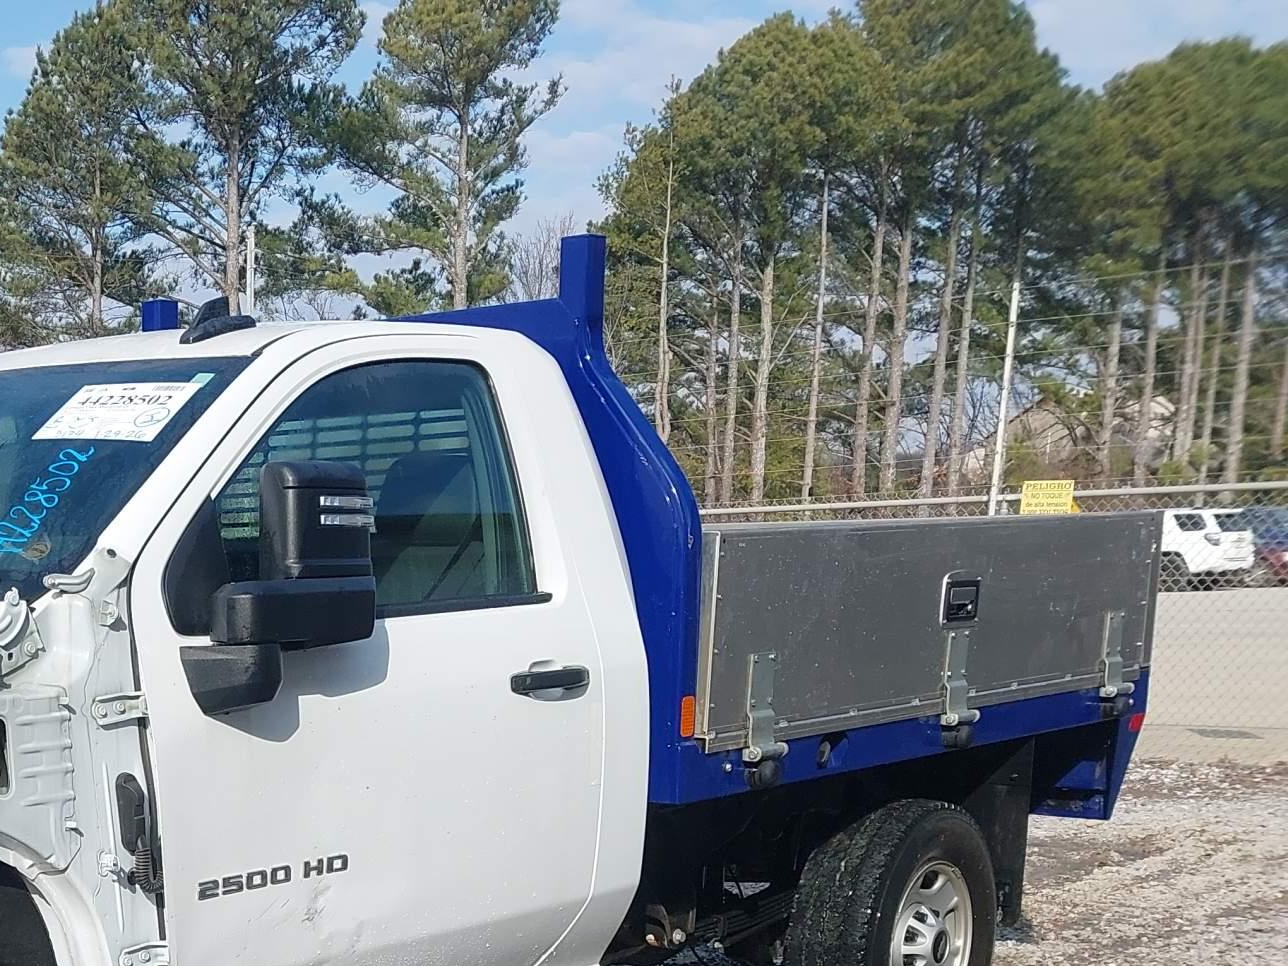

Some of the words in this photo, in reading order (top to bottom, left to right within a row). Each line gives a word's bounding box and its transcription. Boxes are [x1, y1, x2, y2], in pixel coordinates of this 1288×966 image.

[78, 395, 173, 406] 44228502
[1025, 482, 1072, 490] PELIGRO
[198, 865, 292, 901] 2500
[303, 854, 349, 879] HD
